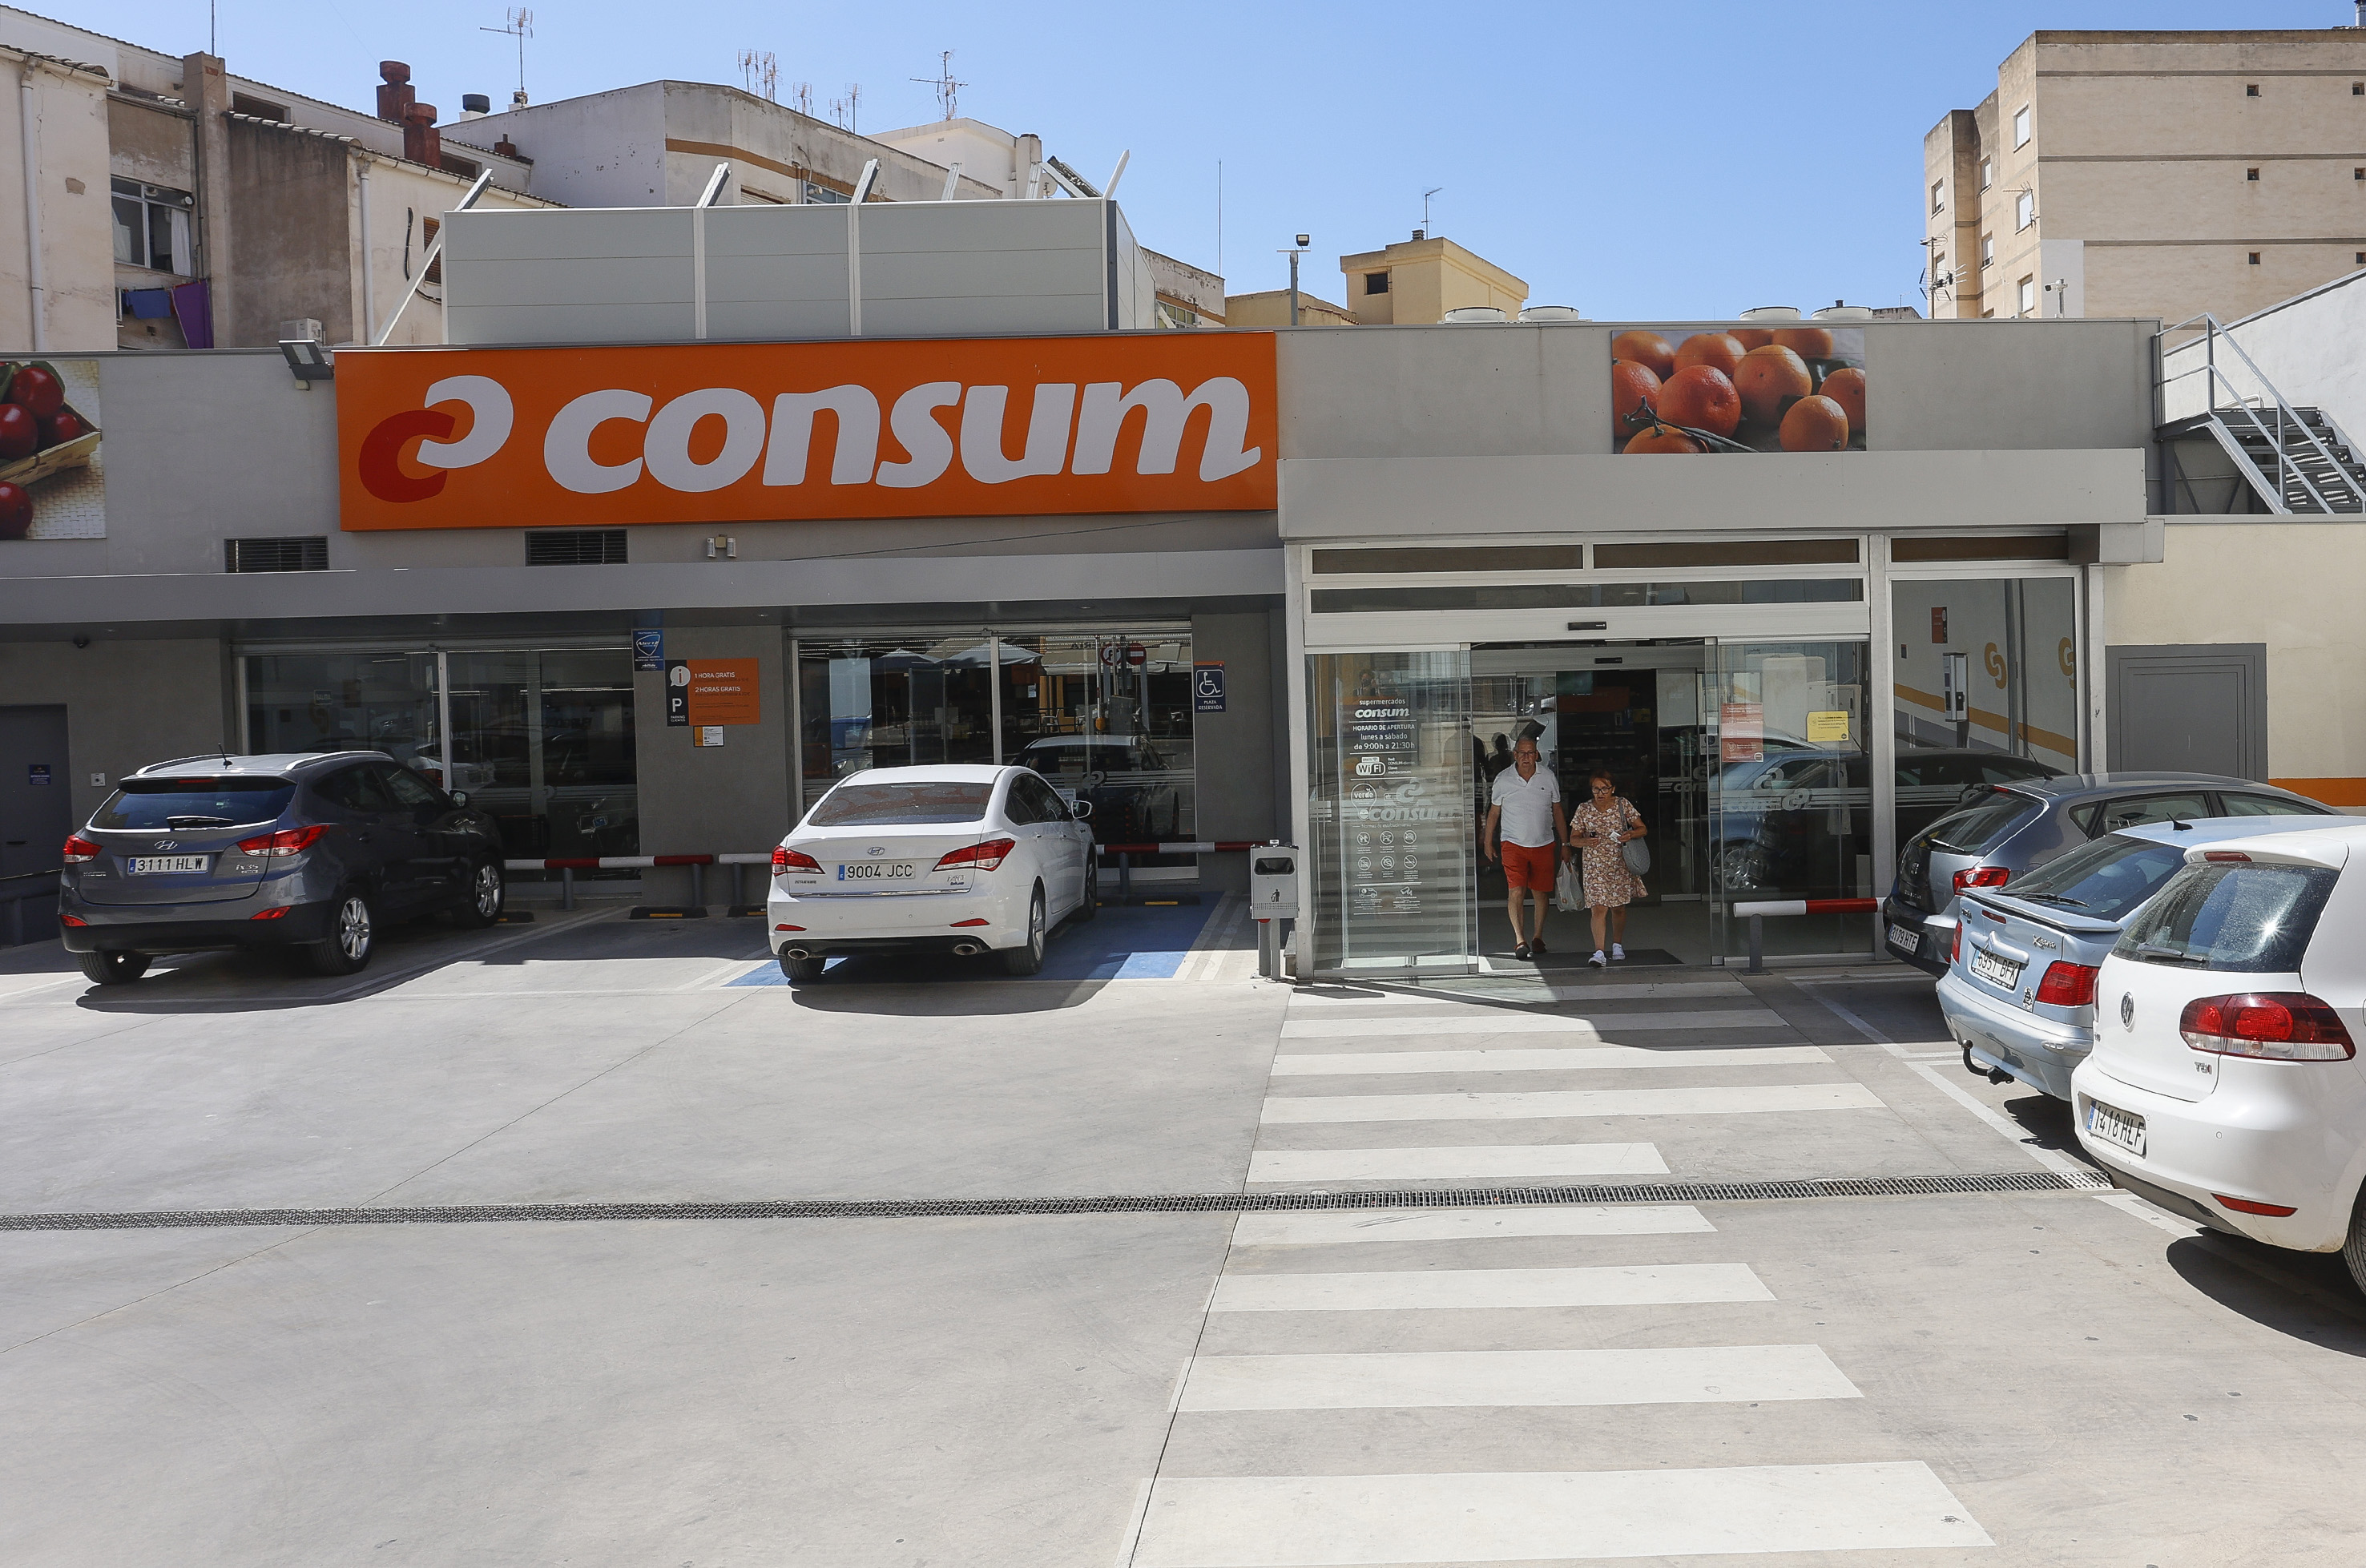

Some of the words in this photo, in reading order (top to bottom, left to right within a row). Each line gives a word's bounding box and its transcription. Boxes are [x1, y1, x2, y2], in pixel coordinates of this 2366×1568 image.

[543, 377, 1261, 494] consum
[671, 698, 683, 712] P
[1359, 698, 1405, 706] supermercados
[1355, 707, 1410, 718] consum
[1353, 791, 1374, 799] verde
[137, 859, 171, 872] 3111
[175, 857, 204, 870] HLW
[846, 865, 881, 878] 9004
[886, 864, 913, 878] JCC
[1892, 927, 1905, 945] 3179
[1904, 933, 1917, 953] HTF
[1999, 958, 2019, 982] BFK
[2094, 1106, 2121, 1138] 1418
[2119, 1115, 2145, 1147] HLF
